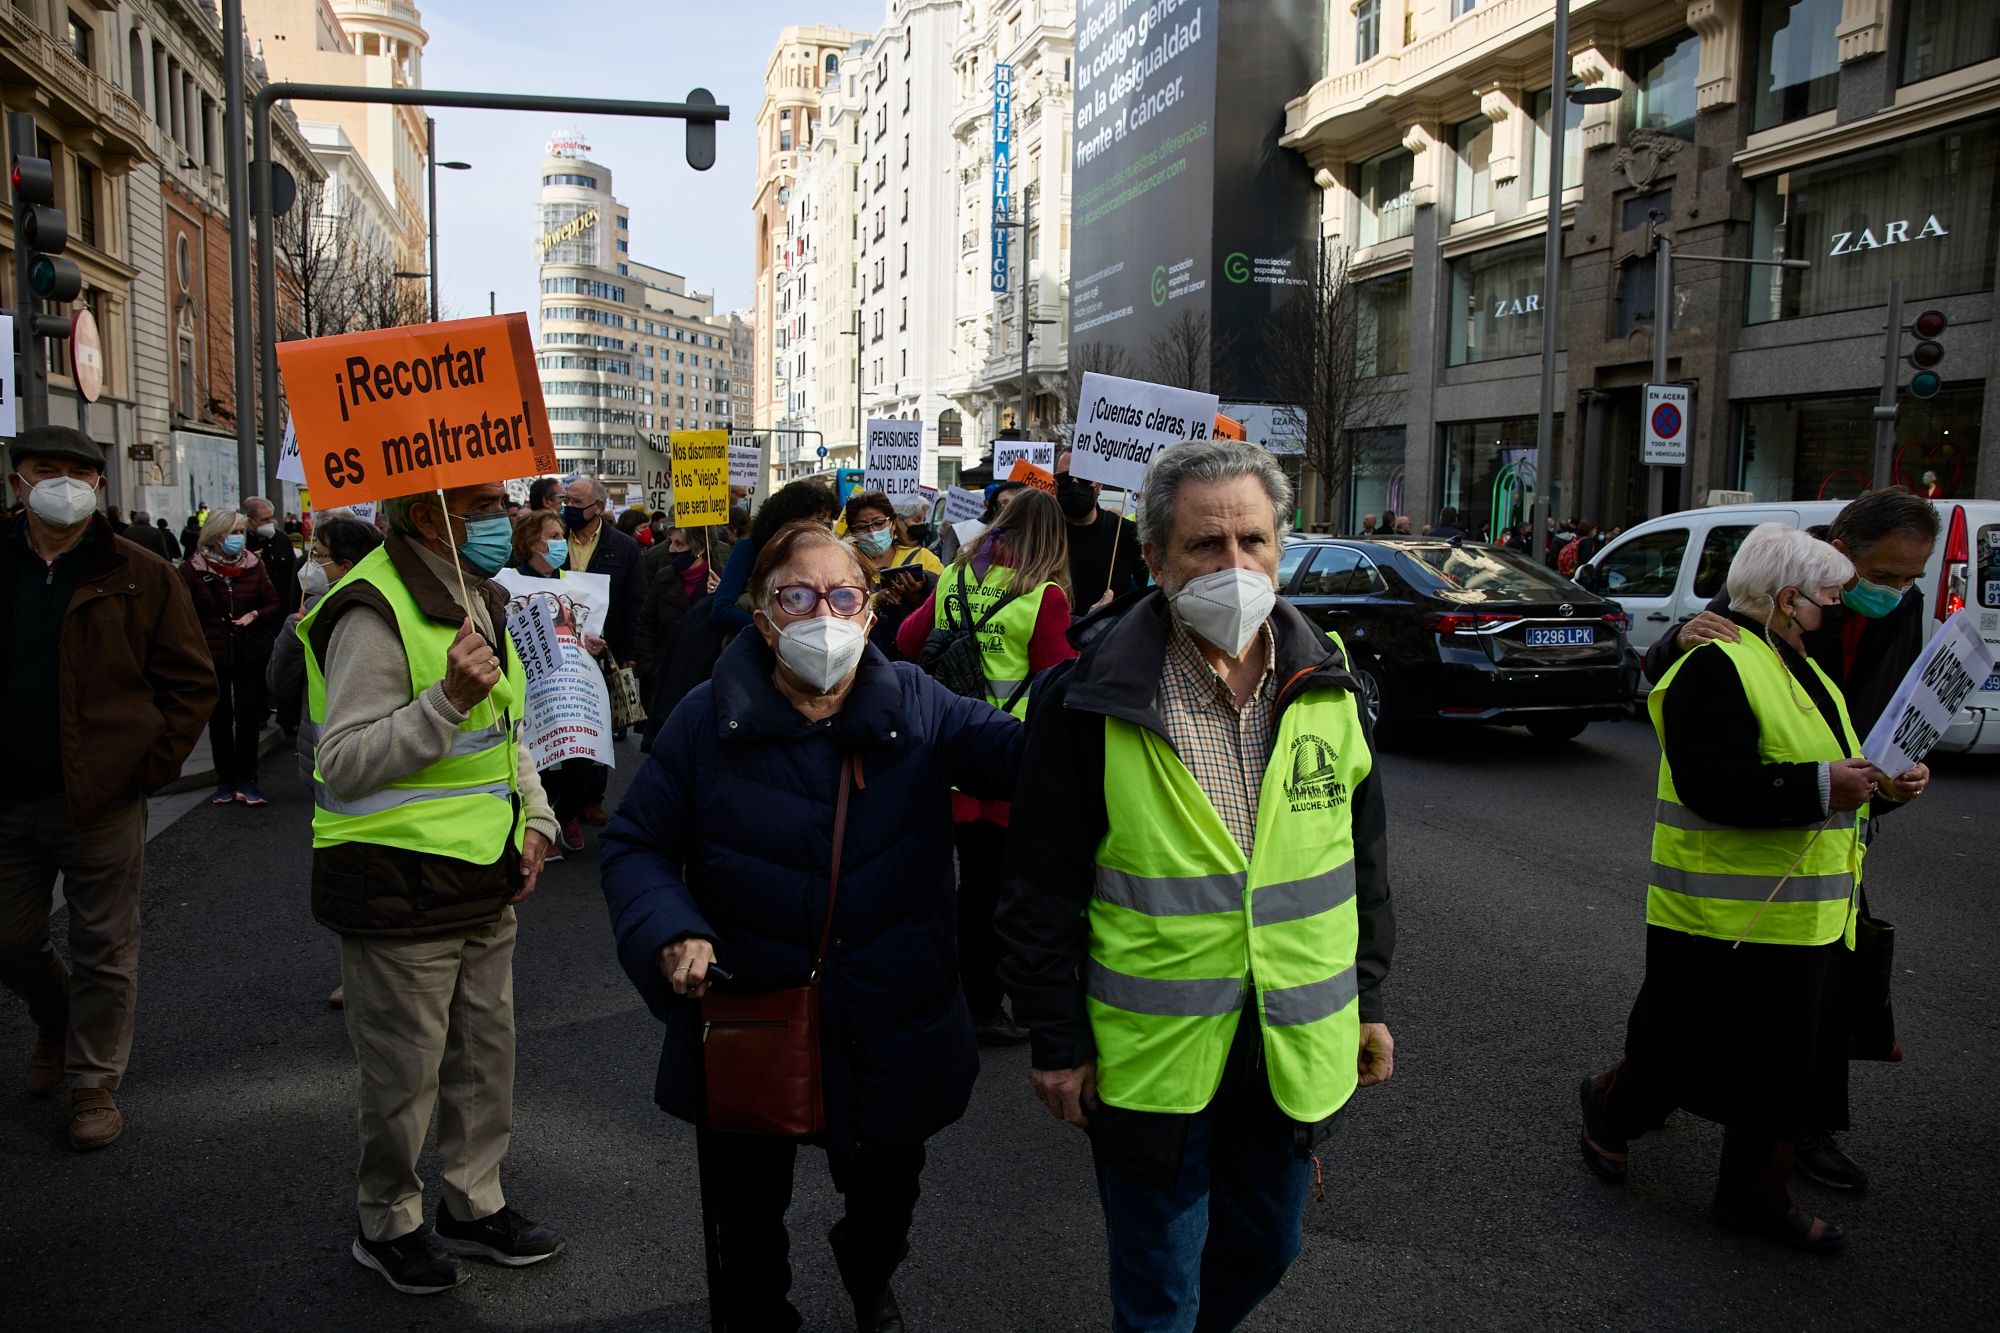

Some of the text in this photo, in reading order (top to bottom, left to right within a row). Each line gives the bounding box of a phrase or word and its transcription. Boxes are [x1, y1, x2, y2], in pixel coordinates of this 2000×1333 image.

[1077, 102, 1092, 130] en
[1095, 89, 1106, 117] la
[1109, 7, 1201, 105] desigualdad
[1079, 65, 1091, 91] tu
[1093, 24, 1136, 78] código
[997, 66, 1009, 143] HOTEL
[1077, 75, 1184, 168] frente al cáncer.
[1830, 214, 1949, 256] ZARA
[1495, 294, 1545, 317] ZAR
[335, 343, 486, 422] ¡Recortar
[1649, 392, 1685, 401] EN ACERA
[1089, 397, 1144, 428] ¡Cuentas
[1145, 408, 1186, 440] claras,
[1190, 420, 1208, 441] ya.
[324, 401, 535, 489] es maltratar!
[673, 441, 725, 460] Nos discriminan
[869, 431, 919, 451] ¡PENSIONES
[1077, 431, 1153, 464] en Seguridad
[868, 455, 918, 471] AJUSTADAS
[648, 471, 671, 490] LAS
[674, 474, 679, 487] a
[680, 470, 693, 488] los
[694, 467, 721, 491] "viejos"
[866, 478, 884, 493] CON
[887, 478, 898, 494] EL
[649, 491, 666, 510] SE
[676, 501, 690, 519] que
[691, 496, 708, 514] serán
[709, 494, 727, 516] luego!
[981, 586, 1009, 599] QUIEN
[529, 604, 554, 669] Maltratar
[977, 623, 1005, 635] BLICAS
[1535, 628, 1591, 644] 3296 LPK
[518, 615, 545, 680] al mayor,
[556, 703, 591, 713] CUENTAS
[542, 749, 566, 766] LUCHA
[569, 746, 596, 757] SIGUE
